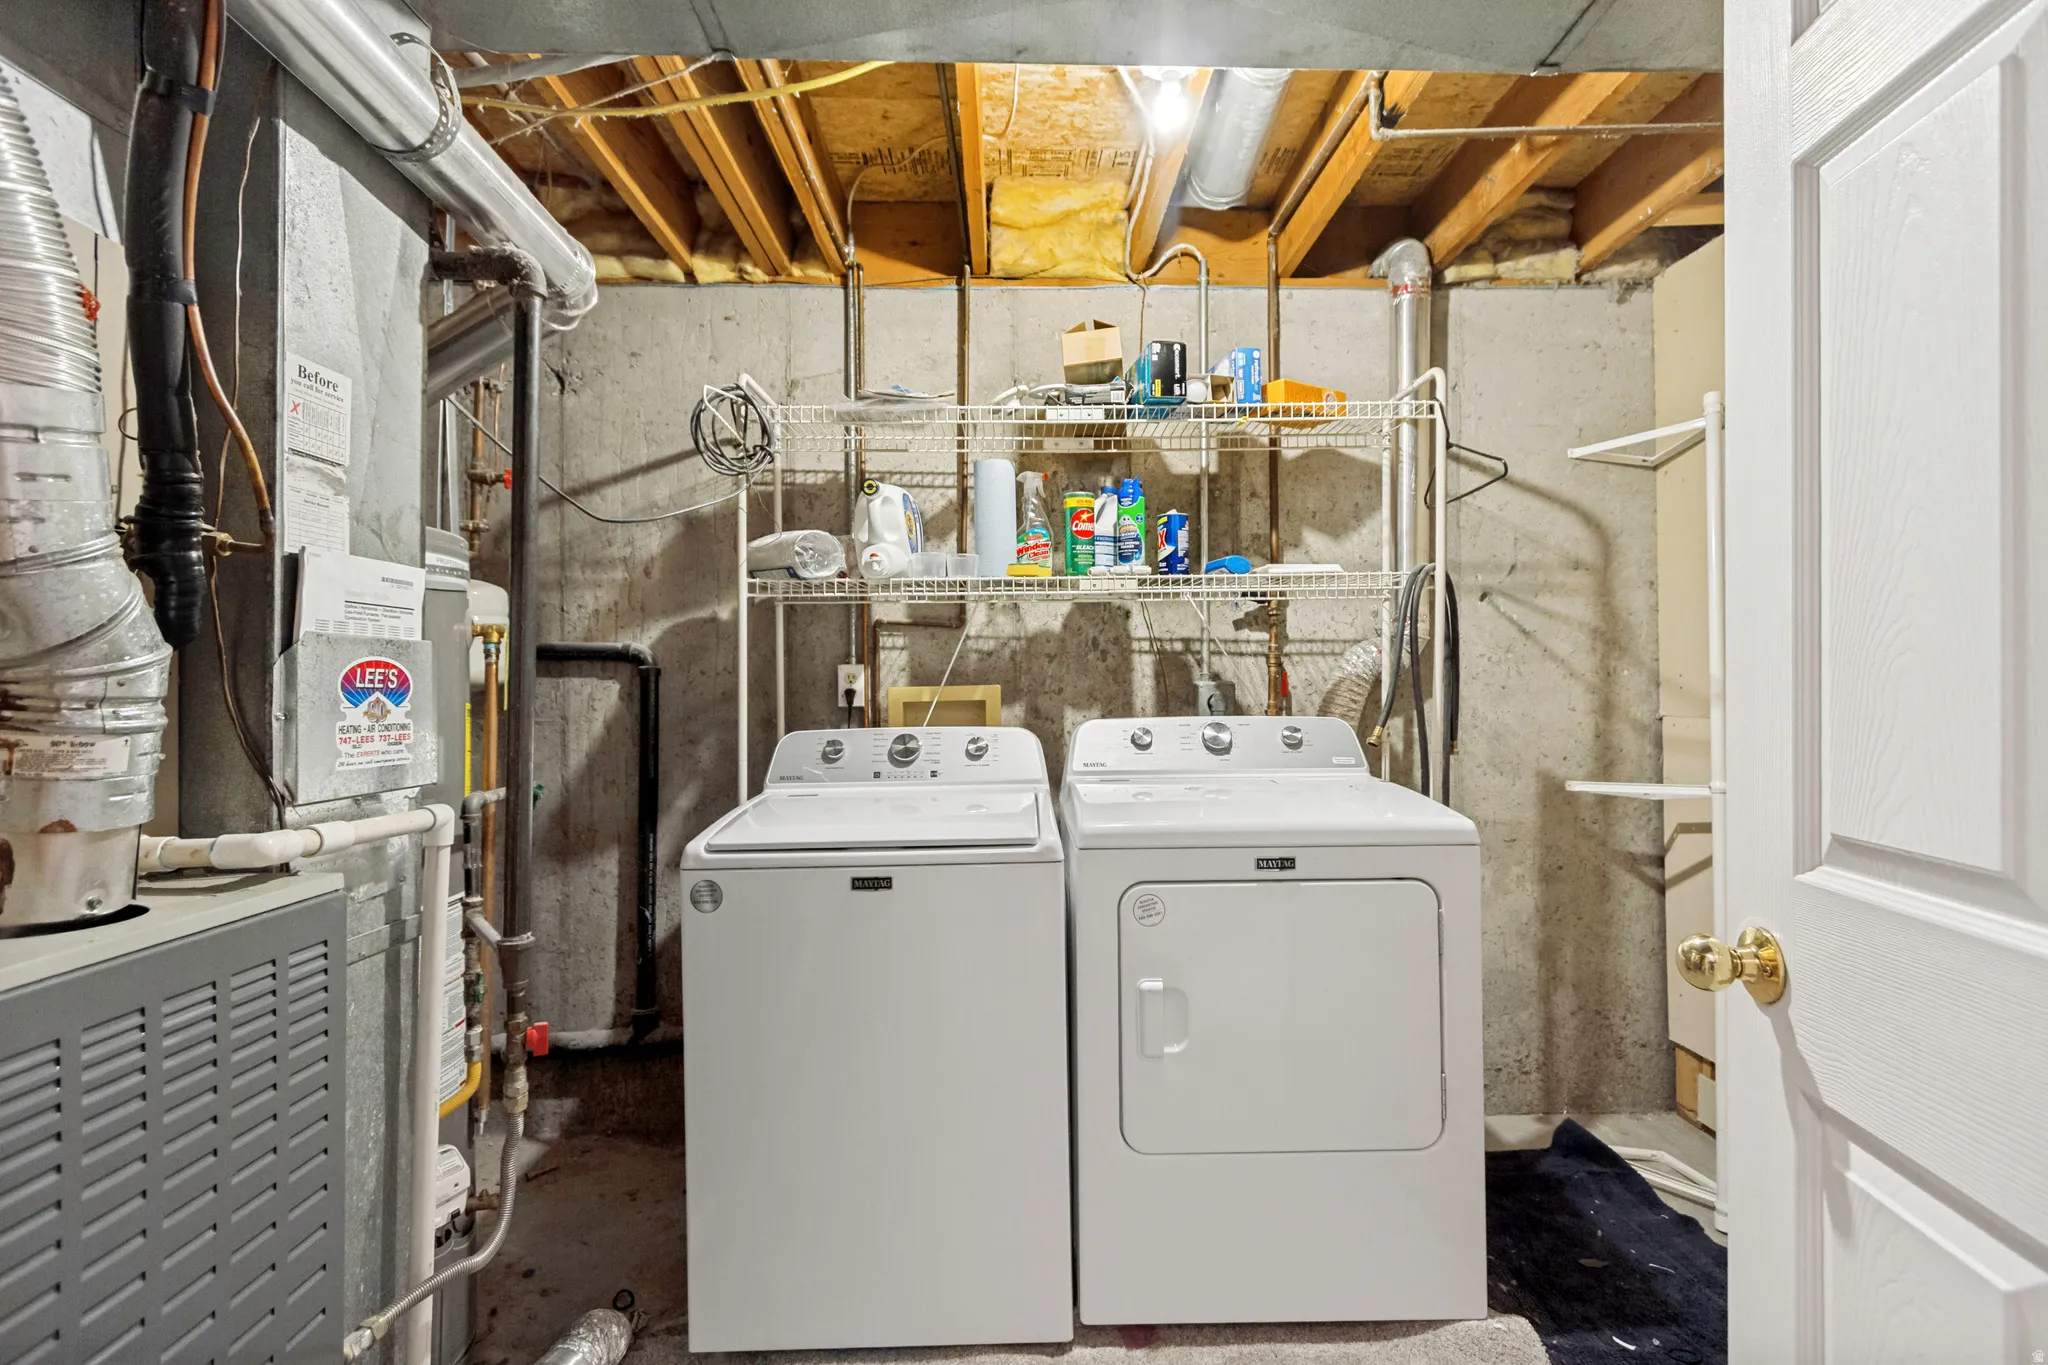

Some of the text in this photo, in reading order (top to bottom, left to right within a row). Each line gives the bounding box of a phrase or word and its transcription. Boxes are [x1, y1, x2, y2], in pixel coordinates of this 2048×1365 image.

[297, 363, 339, 393] Before
[303, 383, 314, 391] call
[325, 391, 344, 403] service
[1072, 520, 1095, 531] Come
[1016, 542, 1051, 557] Window
[1028, 550, 1049, 559] Clean
[355, 667, 398, 689] LEE'S
[338, 724, 362, 736] HEATING
[367, 724, 376, 734] AIR
[378, 722, 411, 733] CONDITIONING
[338, 733, 411, 745] 747-LEES 737-LEES
[356, 750, 380, 758] EXPERTS
[1258, 859, 1295, 868] MAYTAG
[853, 879, 891, 888] MAYTAG
